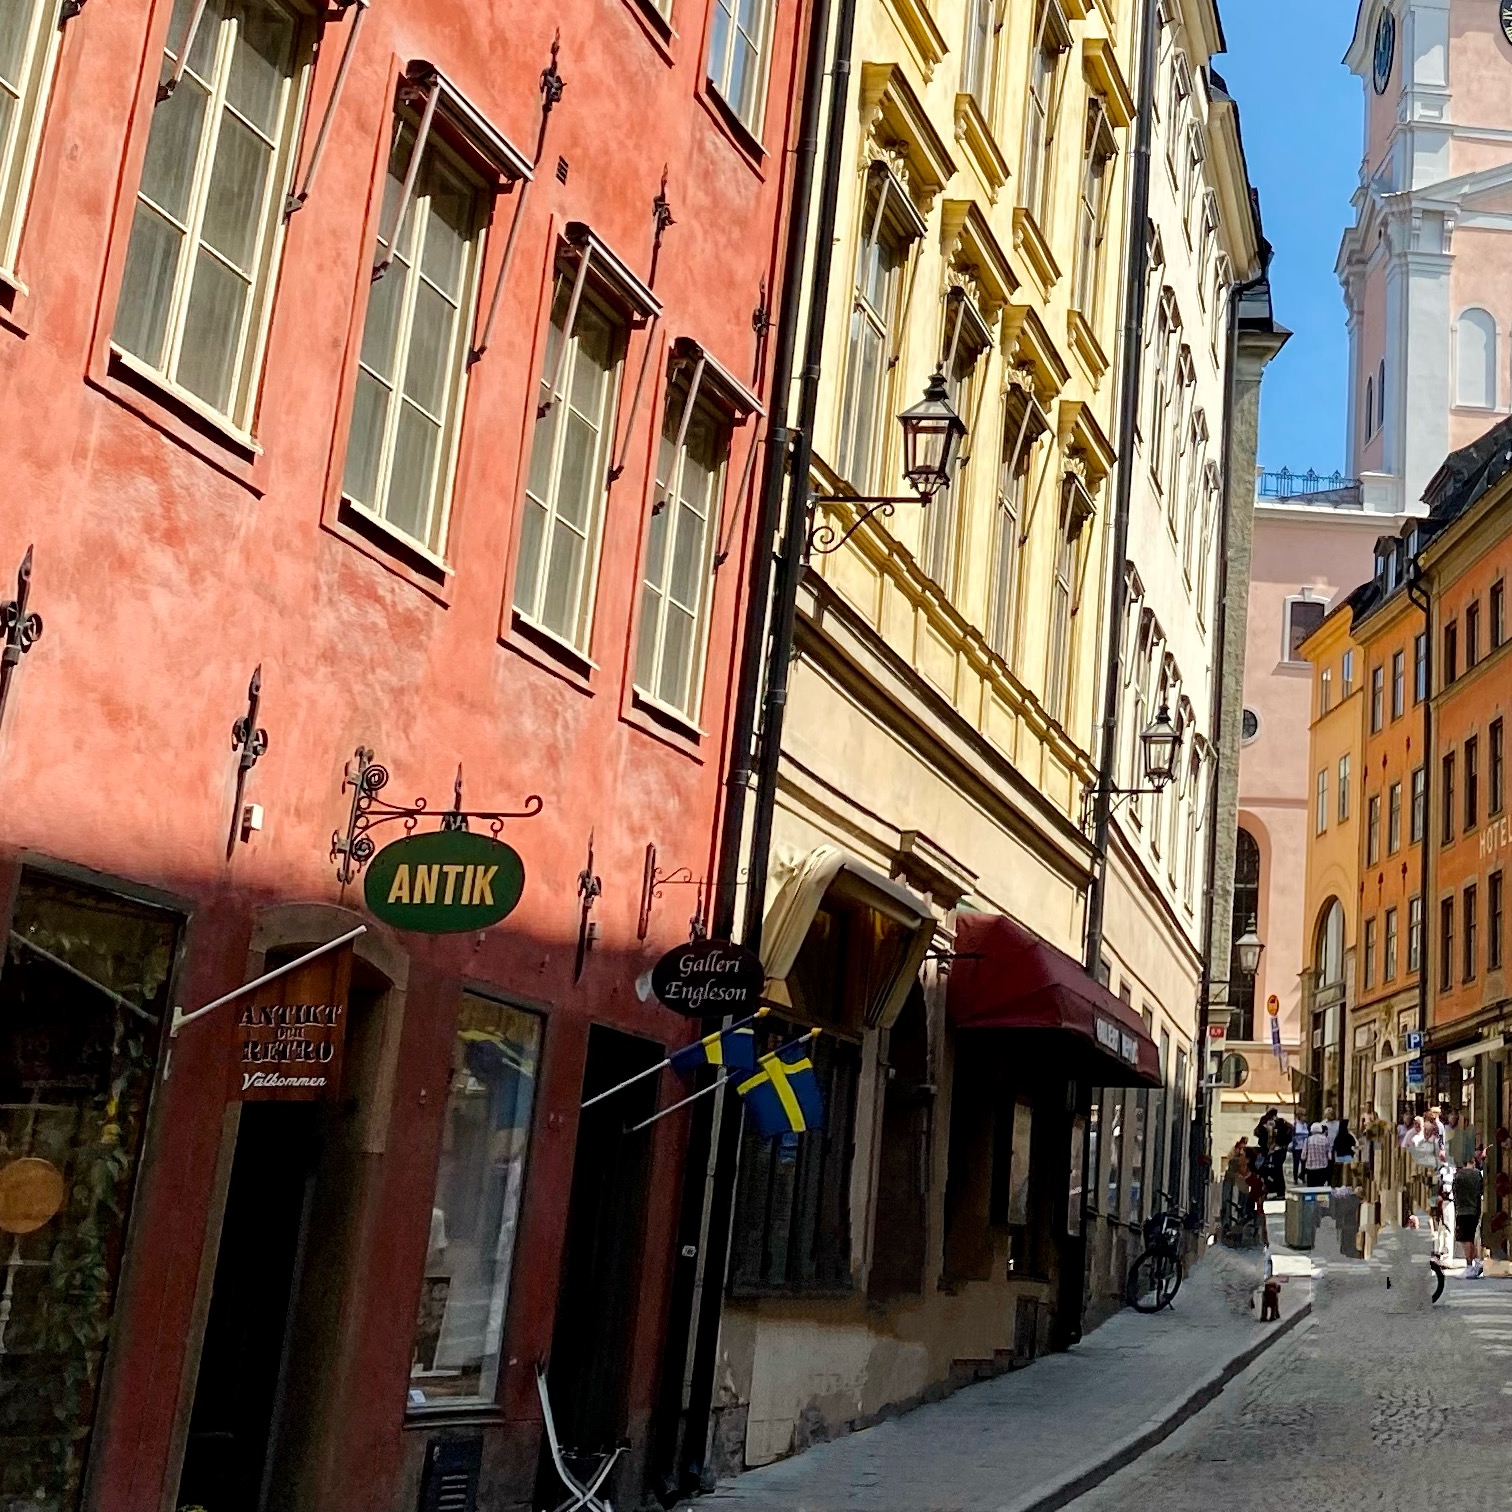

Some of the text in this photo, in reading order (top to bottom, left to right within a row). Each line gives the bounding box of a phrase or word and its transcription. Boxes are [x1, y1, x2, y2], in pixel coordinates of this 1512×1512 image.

[387, 864, 499, 905] ANTIK
[679, 950, 743, 977] Galleri
[664, 978, 747, 1008] Engleson
[239, 1004, 342, 1027] ANTIKT
[242, 1040, 335, 1063] RETRO
[1410, 1034, 1420, 1048] P
[241, 1071, 328, 1091] Välkommen
